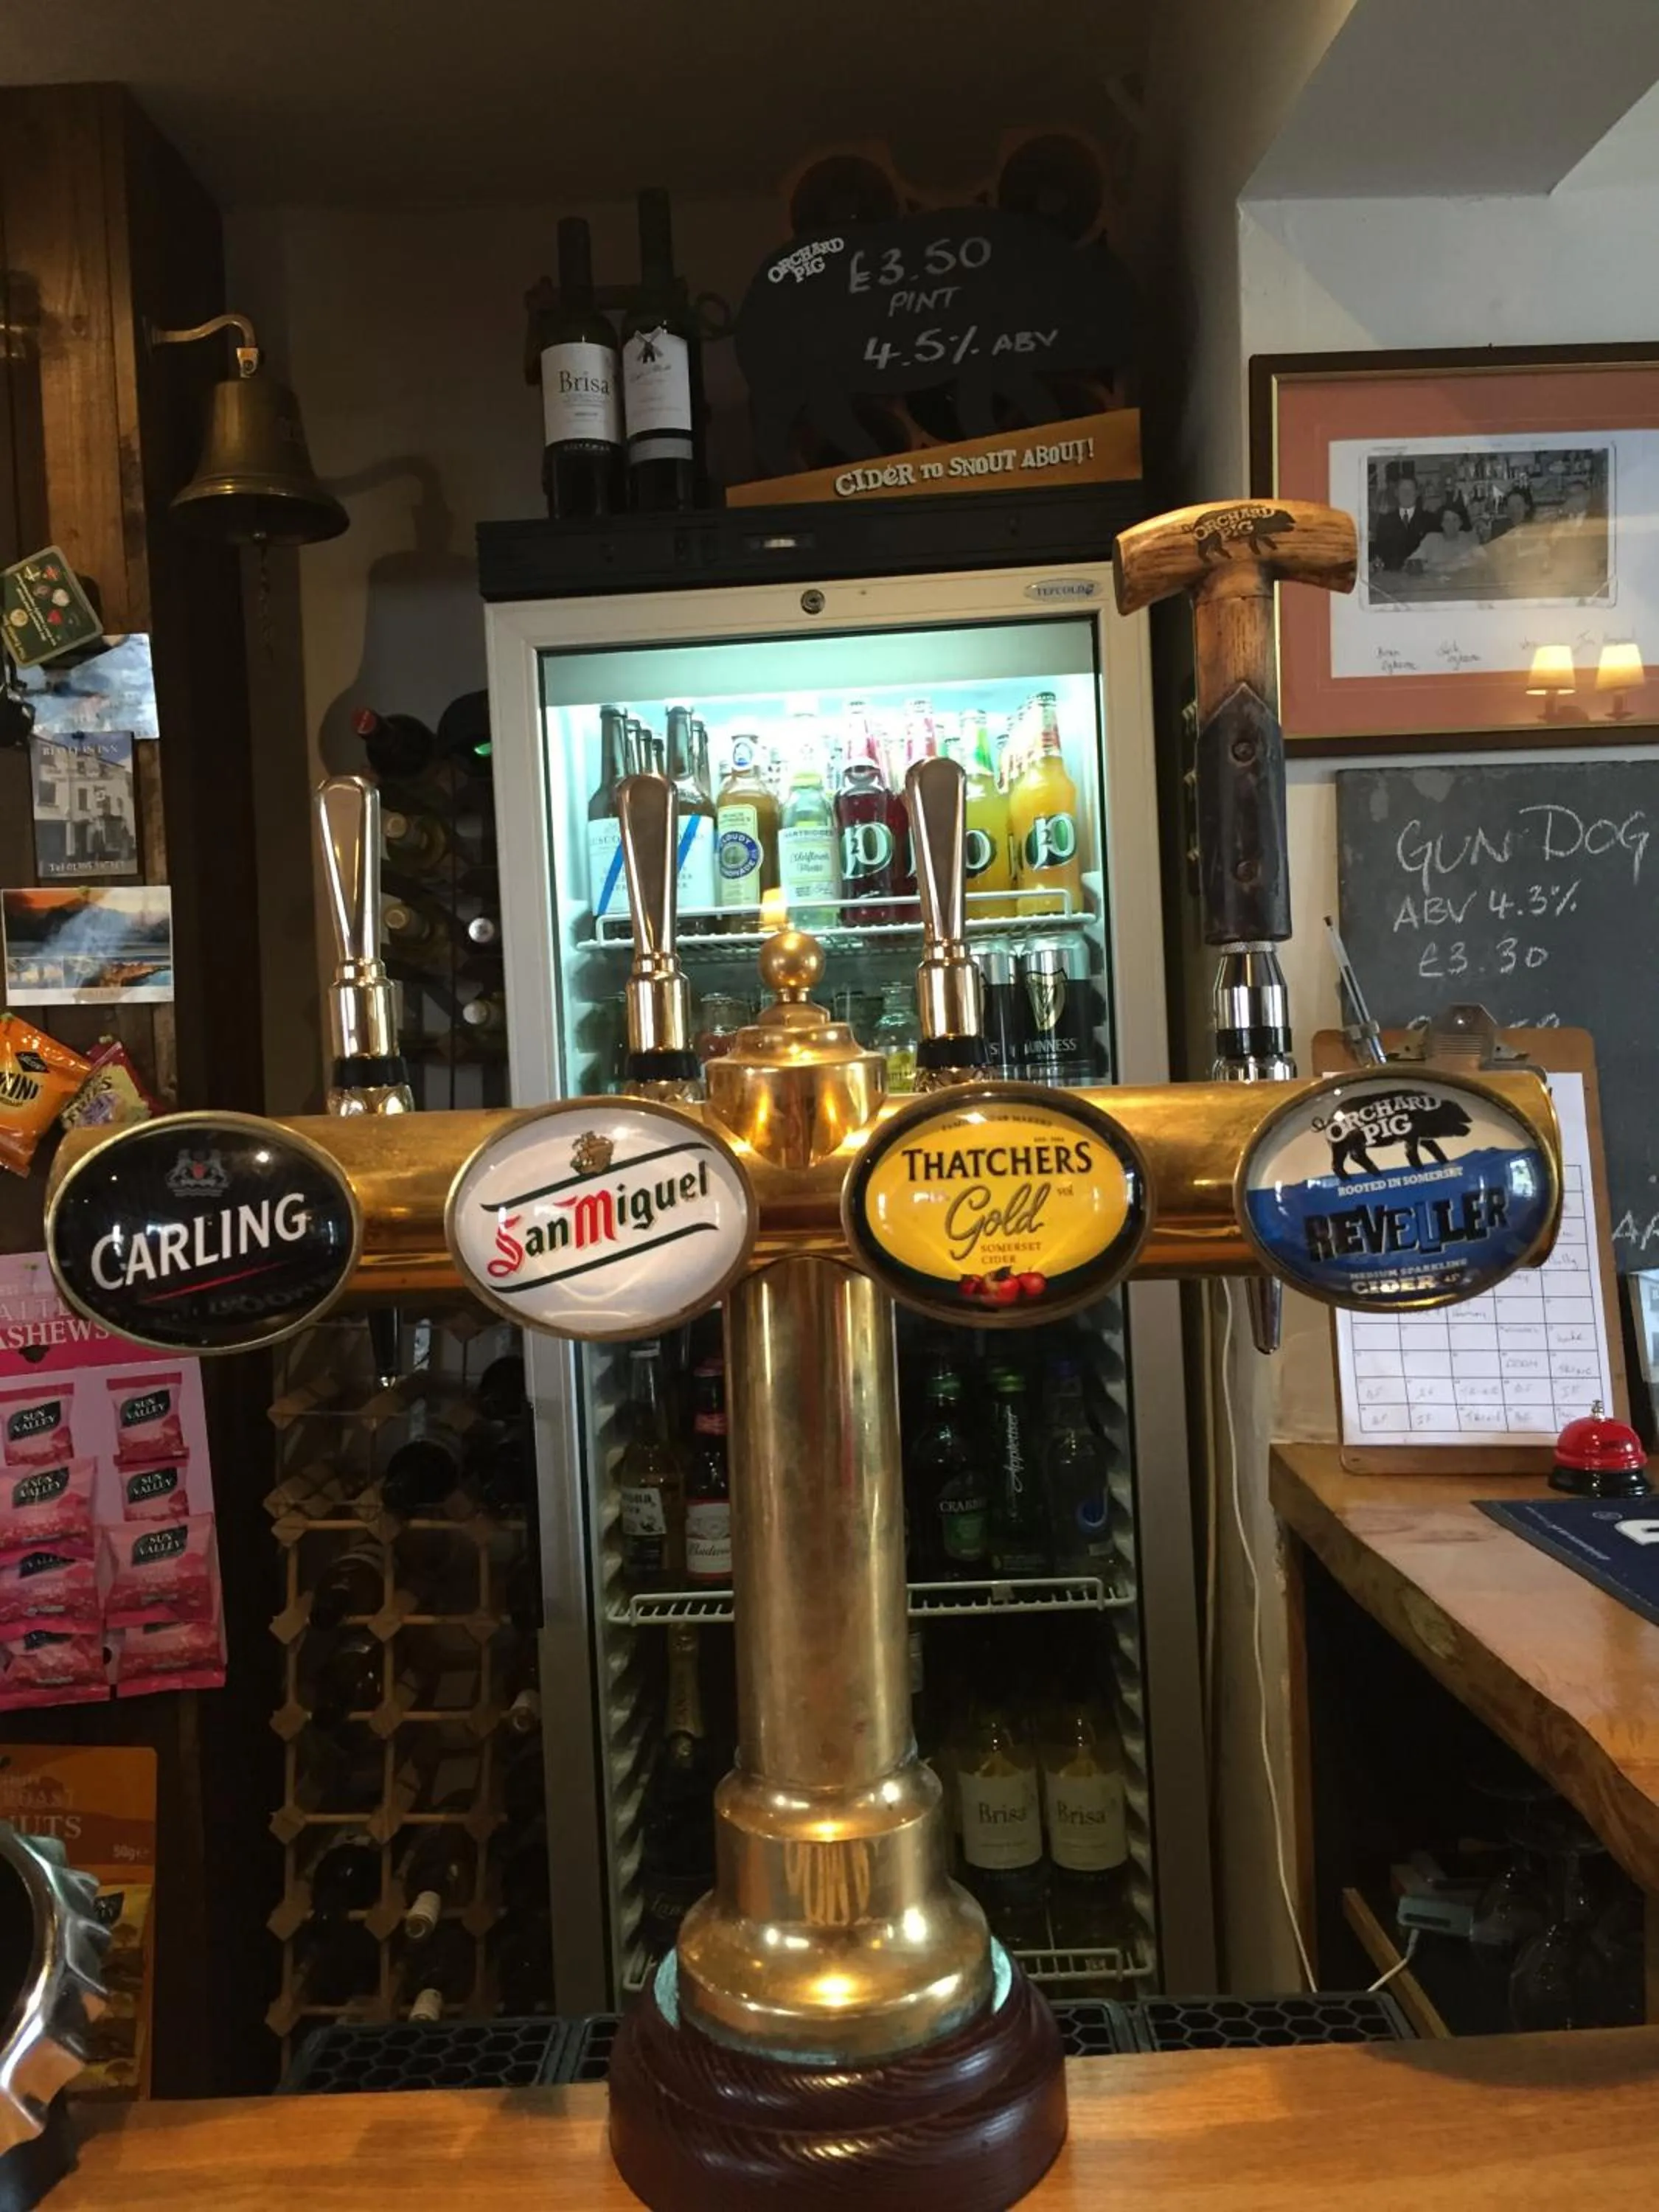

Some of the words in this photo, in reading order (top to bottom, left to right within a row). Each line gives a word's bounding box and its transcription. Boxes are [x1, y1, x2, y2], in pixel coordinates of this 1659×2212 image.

[768, 237, 845, 283] ORCHARD
[794, 257, 826, 283] PIG
[849, 237, 992, 293] £3.50
[888, 287, 960, 317] PINT
[991, 329, 1059, 355] ABV
[559, 370, 611, 395] Brisa
[948, 450, 1016, 479] SNOUT
[1192, 506, 1276, 540] ORCHARD
[1220, 518, 1254, 540] PIG
[1397, 819, 1511, 894] GUN
[1519, 804, 1650, 885] DOG
[1394, 891, 1477, 932] ABV
[1488, 880, 1582, 919] 4.3%
[1326, 1093, 1441, 1144] ORCHARD
[1362, 1113, 1413, 1146] PIG
[902, 1140, 1093, 1181] THATCHERS
[1338, 1183, 1384, 1197] ROOTED
[1387, 1180, 1402, 1189] IN
[1403, 1166, 1464, 1185] SOMERSET
[944, 1182, 1052, 1261] Gold
[1304, 1189, 1509, 1262] REVELLER
[91, 1192, 307, 1290] CARLING
[980, 1241, 1043, 1254] SOMERSET
[981, 1255, 1016, 1265] CIDER
[1352, 1277, 1436, 1295] CIDER
[0, 1318, 109, 1350] SHEWS
